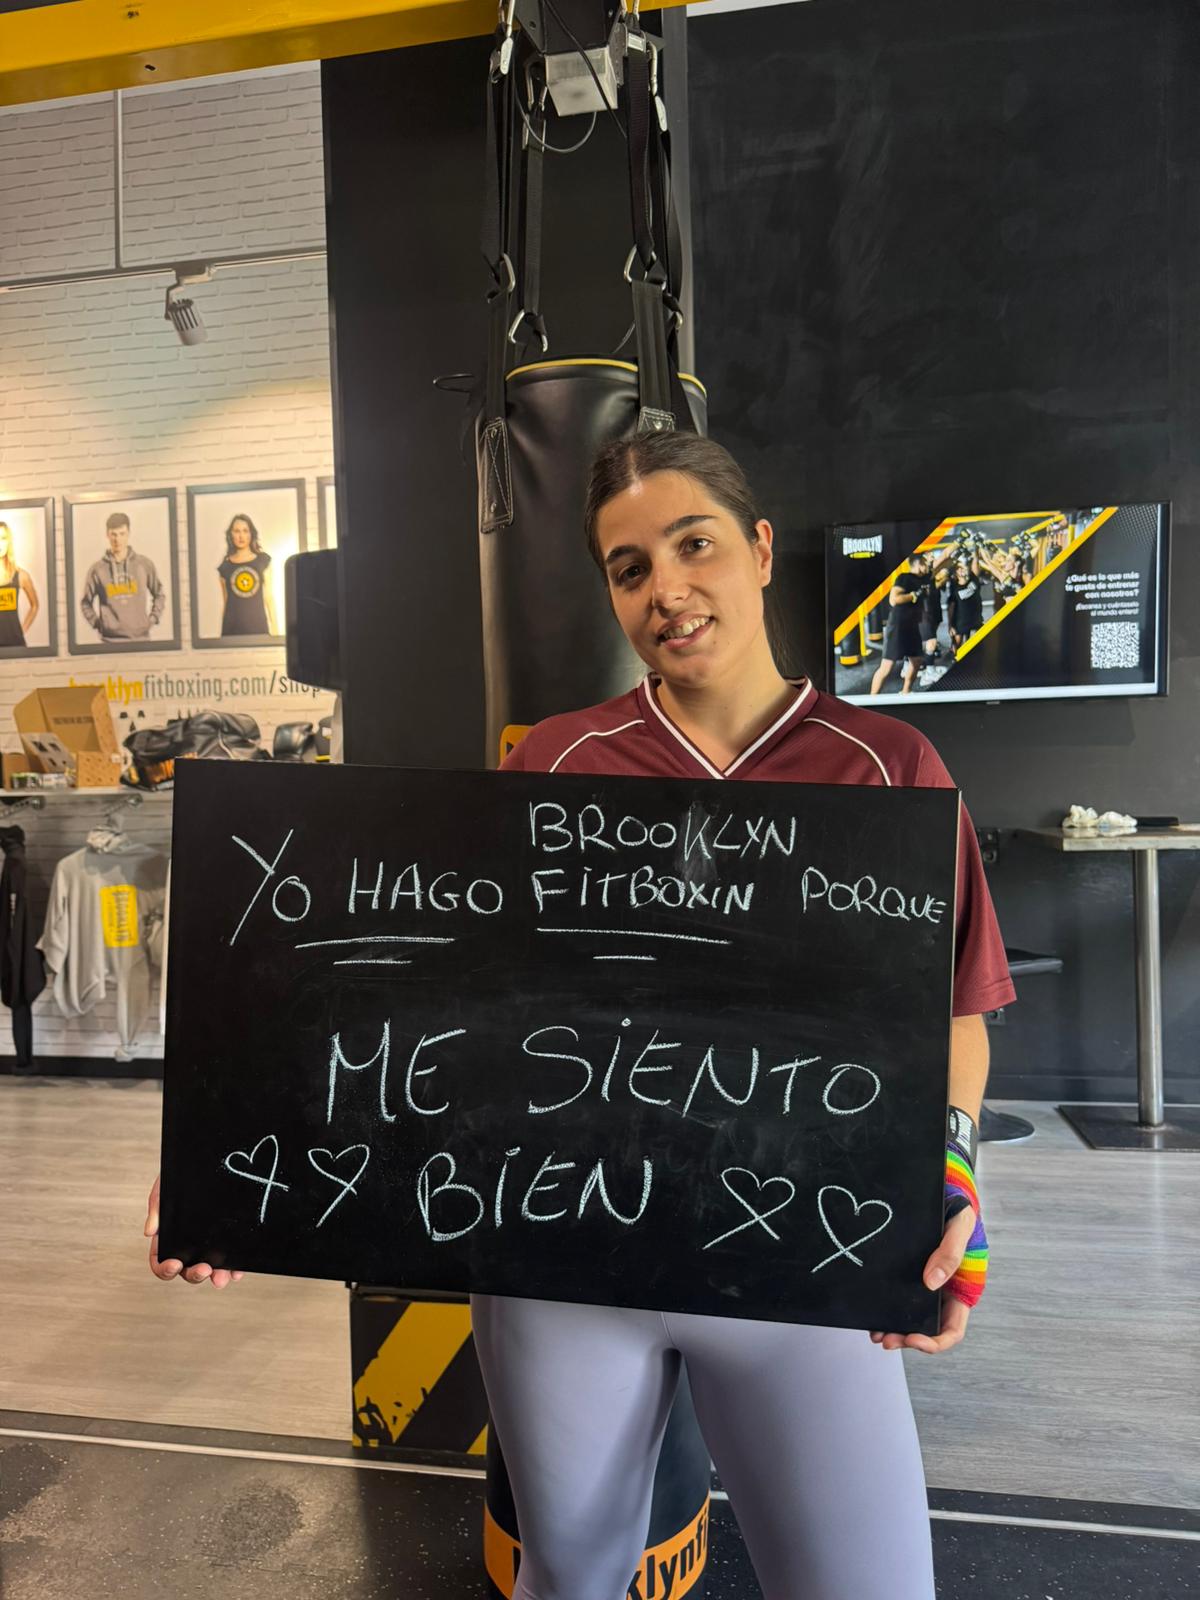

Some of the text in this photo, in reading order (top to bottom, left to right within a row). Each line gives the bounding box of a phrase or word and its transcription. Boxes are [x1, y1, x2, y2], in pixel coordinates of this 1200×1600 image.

[1065, 581, 1140, 593] te gusta de entrenar
[1087, 574, 1097, 582] es
[1098, 572, 1106, 581] lo
[1107, 573, 1122, 582] que
[1123, 571, 1140, 580] más
[1100, 588, 1140, 598] nosotros?
[529, 801, 797, 862] BROOKLYN
[348, 857, 503, 915] HAGO
[801, 866, 948, 924] PORQUE
[326, 1018, 467, 1125] ME
